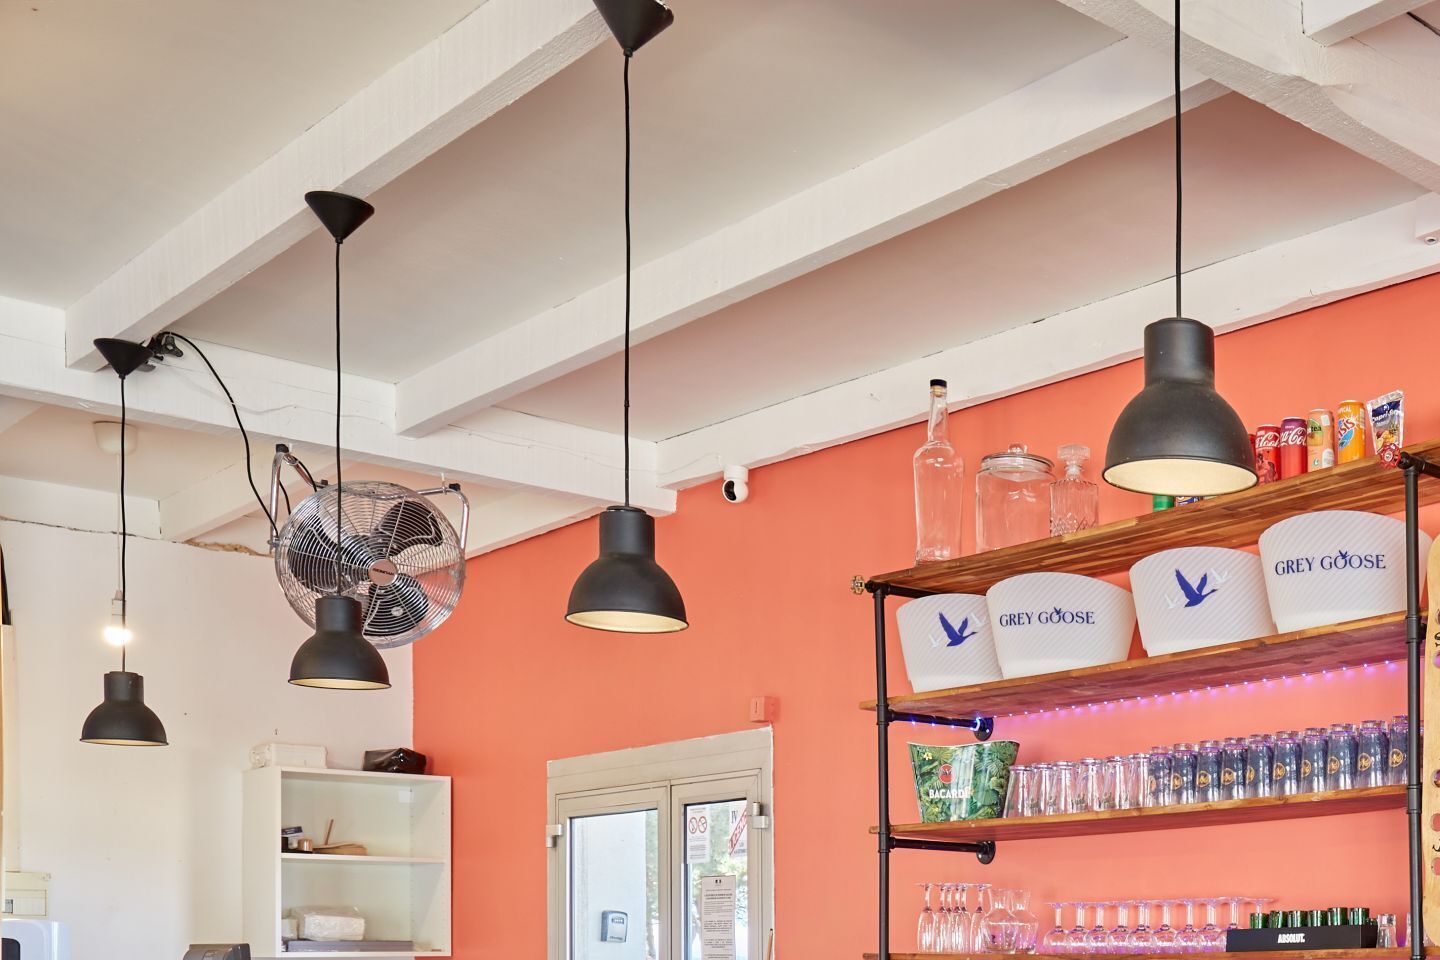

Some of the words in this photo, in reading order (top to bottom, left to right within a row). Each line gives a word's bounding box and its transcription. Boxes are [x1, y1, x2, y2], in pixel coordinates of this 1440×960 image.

[1275, 557, 1315, 576] GREY
[1320, 551, 1386, 571] GOOSE
[999, 611, 1034, 628] GREY
[1038, 607, 1095, 625] GOOSE
